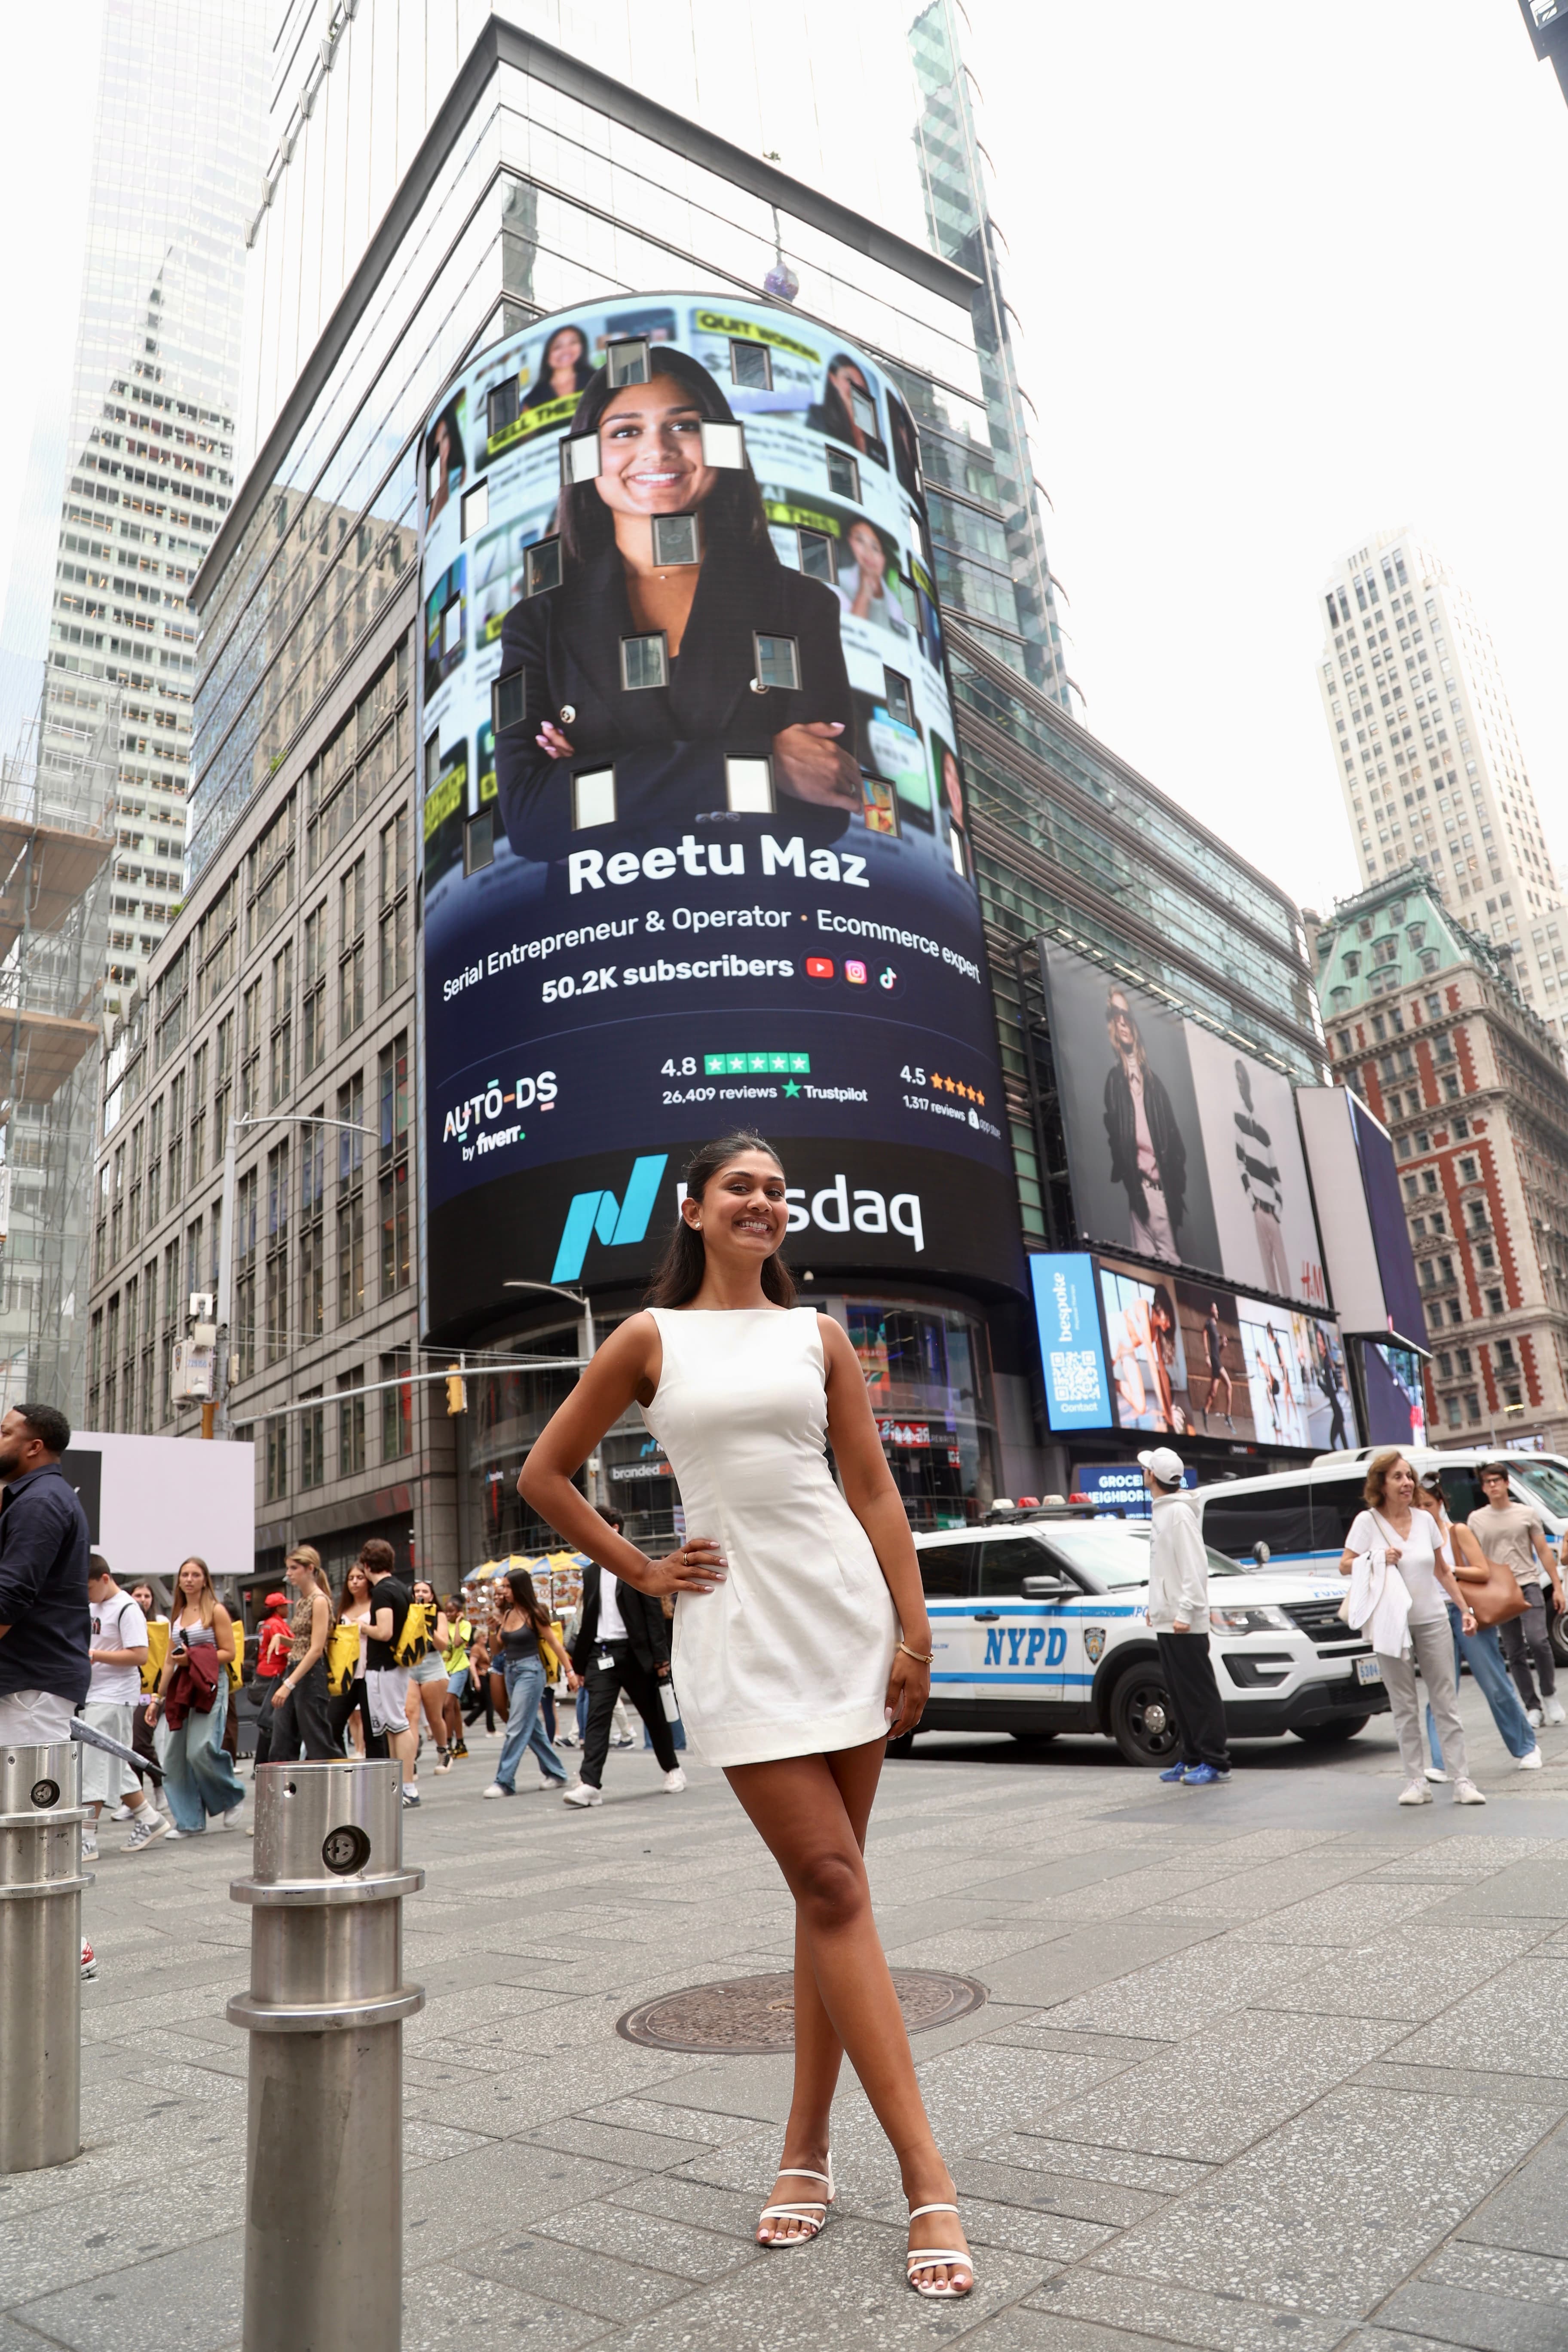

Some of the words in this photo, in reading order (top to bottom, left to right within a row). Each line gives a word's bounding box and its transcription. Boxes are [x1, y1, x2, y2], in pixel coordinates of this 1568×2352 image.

[569, 835, 745, 894] Reetu
[760, 834, 870, 888] Maz
[444, 959, 483, 1001] Serial
[487, 917, 639, 976] Entrepreneur
[645, 910, 665, 932] &
[672, 905, 792, 933] Operator
[817, 909, 939, 957] Ecommerce
[941, 947, 981, 984] expert
[542, 966, 618, 1003] 50.2K
[623, 954, 794, 986] subscribers
[661, 1057, 697, 1077] 4.8
[900, 1065, 926, 1086] 4.5
[662, 1087, 716, 1104] 26,409
[720, 1085, 778, 1099] reviews
[803, 1084, 868, 1102] Trustpilot
[931, 1103, 966, 1121] reviews
[462, 1145, 475, 1161] by
[677, 1174, 925, 1253] sdaq
[1301, 1259, 1325, 1305] H&M
[1053, 1272, 1072, 1341] bespoke
[1060, 1403, 1098, 1412] Contact
[984, 1627, 1067, 1666] NYPD
